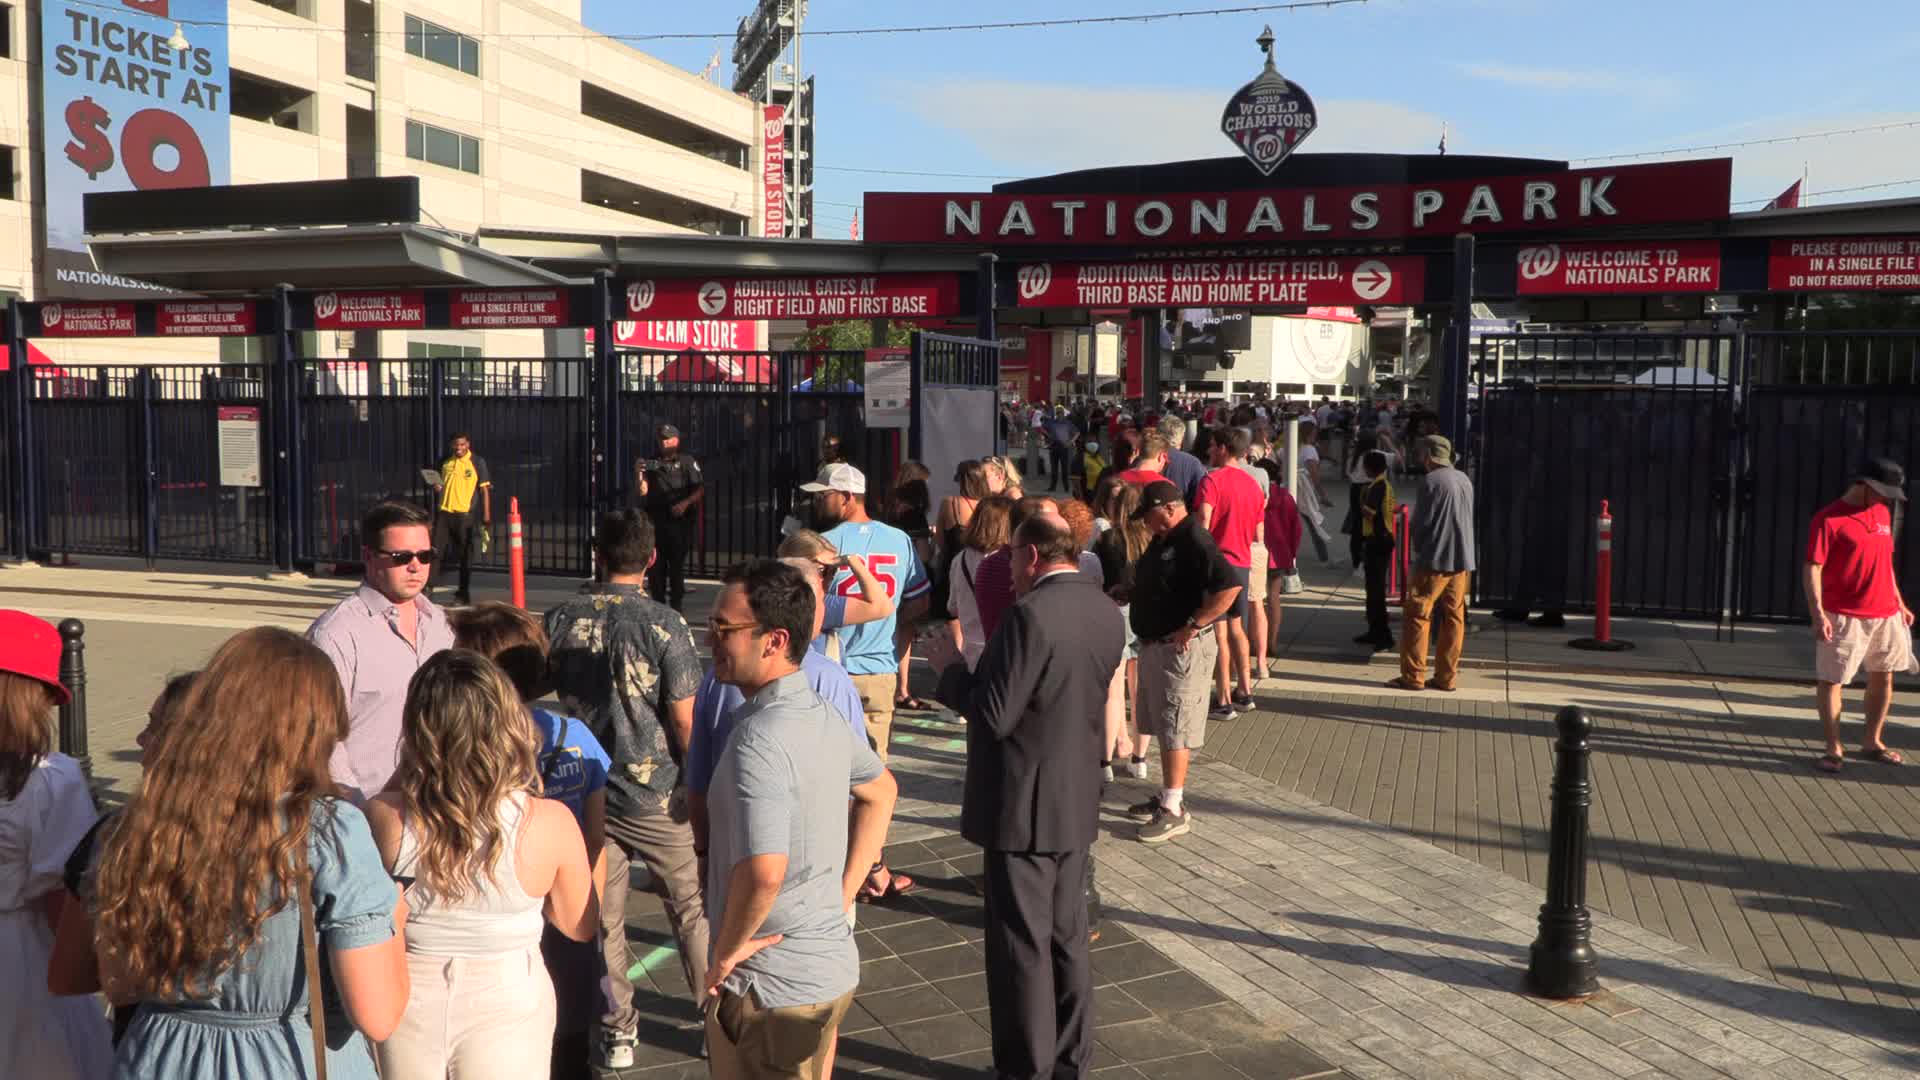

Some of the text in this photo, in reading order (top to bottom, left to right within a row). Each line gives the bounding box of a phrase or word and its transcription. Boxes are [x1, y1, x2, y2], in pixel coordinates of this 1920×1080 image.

[65, 9, 213, 76] TICKETS
[56, 44, 222, 111] START AT
[1240, 101, 1298, 114] WORLD
[1256, 95, 1280, 104] 2019
[1225, 113, 1312, 132] CHAMPIONS
[766, 142, 782, 185] TEAM
[943, 174, 1619, 237] NATIONALS PARK
[1791, 242, 1837, 256] PLEASE
[1840, 241, 1905, 256] CONTINUE
[1565, 249, 1679, 268] WELCOME TO
[1810, 256, 1915, 271] IN A SINGLE FILE
[1077, 262, 1344, 285] ADDITIONAL GATES AT LEFT FIELD,
[1565, 266, 1711, 285] NATIONALS PARK
[1789, 275, 1804, 287] DO
[1807, 275, 1827, 286] NOT
[1829, 275, 1873, 286] REMOVE
[734, 278, 877, 297] ADDITIONAL GATES AT
[1077, 283, 1308, 305] THIRD BASE AND HOME PLATE
[341, 296, 402, 309] WELCOME TO
[472, 302, 546, 313] IN A SINGLE FILE LINE
[734, 296, 927, 316] RIGHT FIELD AND FIRST BASE
[64, 307, 117, 319] WELCOME TO
[187, 313, 208, 323] SINGLE
[208, 313, 222, 323] FILE
[222, 313, 237, 322] LINE
[341, 309, 421, 322] NATIONALS PARK
[1202, 317, 1220, 325] AND
[64, 319, 132, 331] NATIONALS PARK
[647, 320, 738, 349] TEAM STORE
[837, 554, 898, 601] 25
